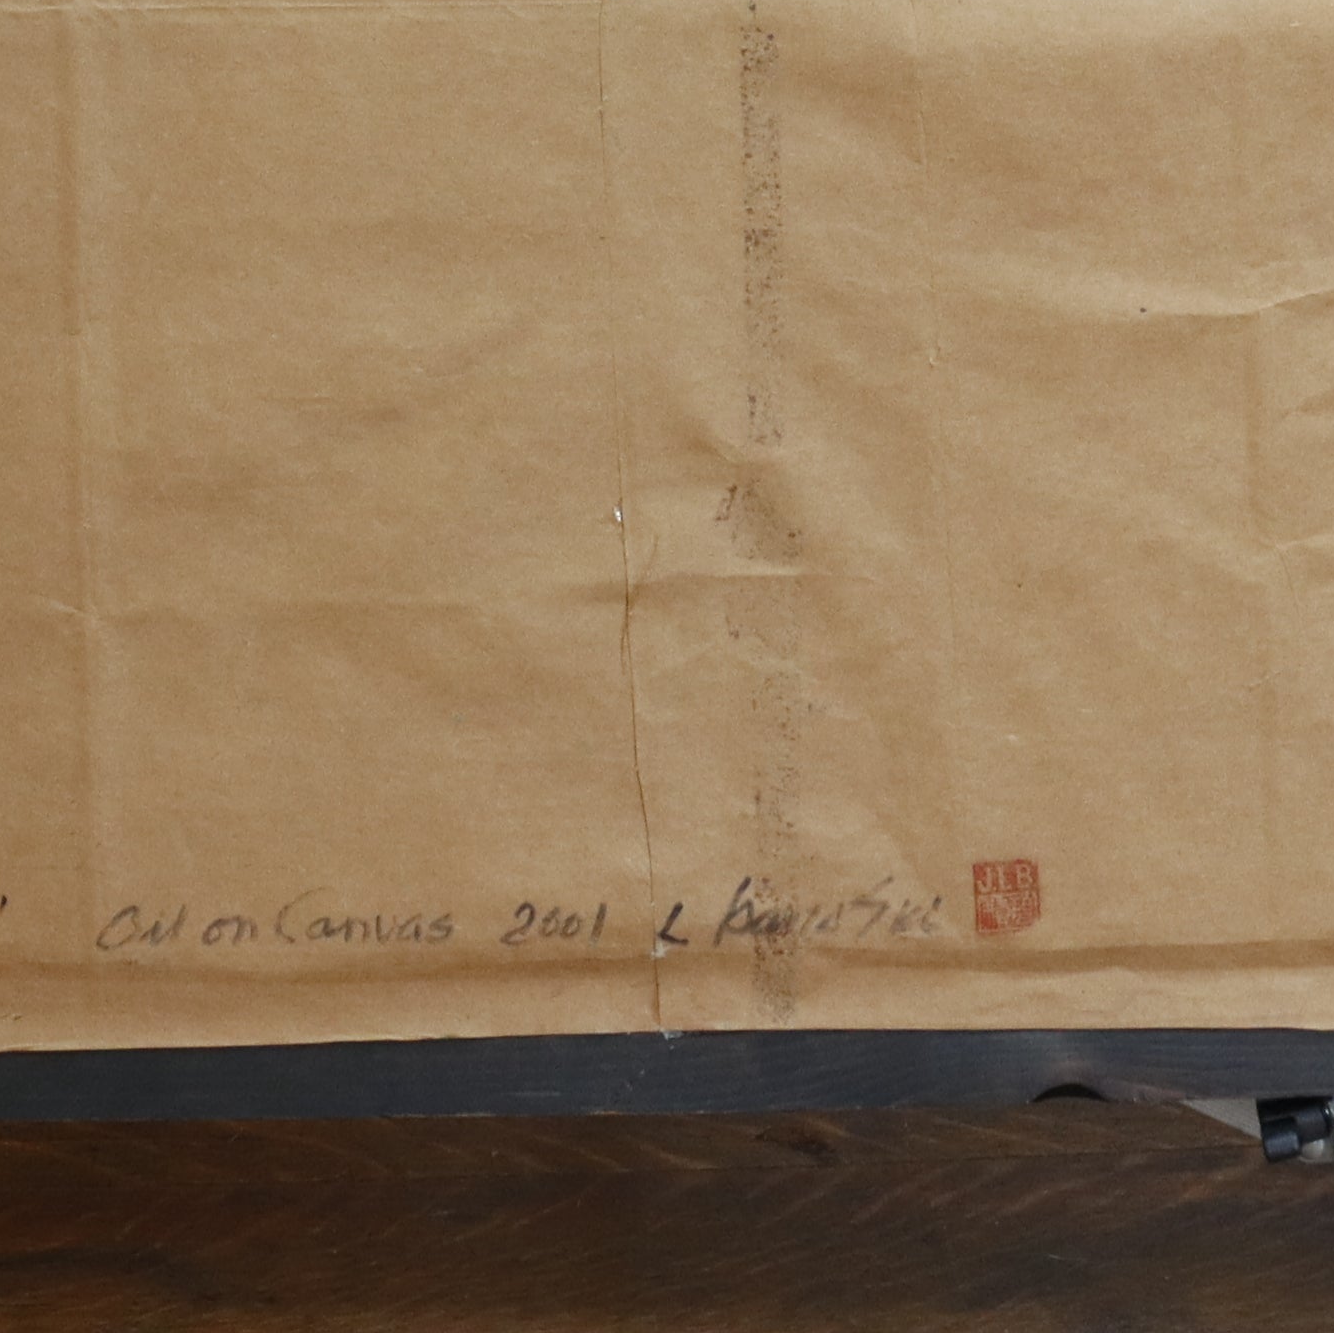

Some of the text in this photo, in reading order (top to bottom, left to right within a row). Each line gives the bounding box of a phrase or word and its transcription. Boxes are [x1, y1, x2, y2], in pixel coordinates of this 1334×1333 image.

[200, 912, 259, 947] on
[274, 886, 456, 946] Canvas
[499, 900, 607, 949] 2001
